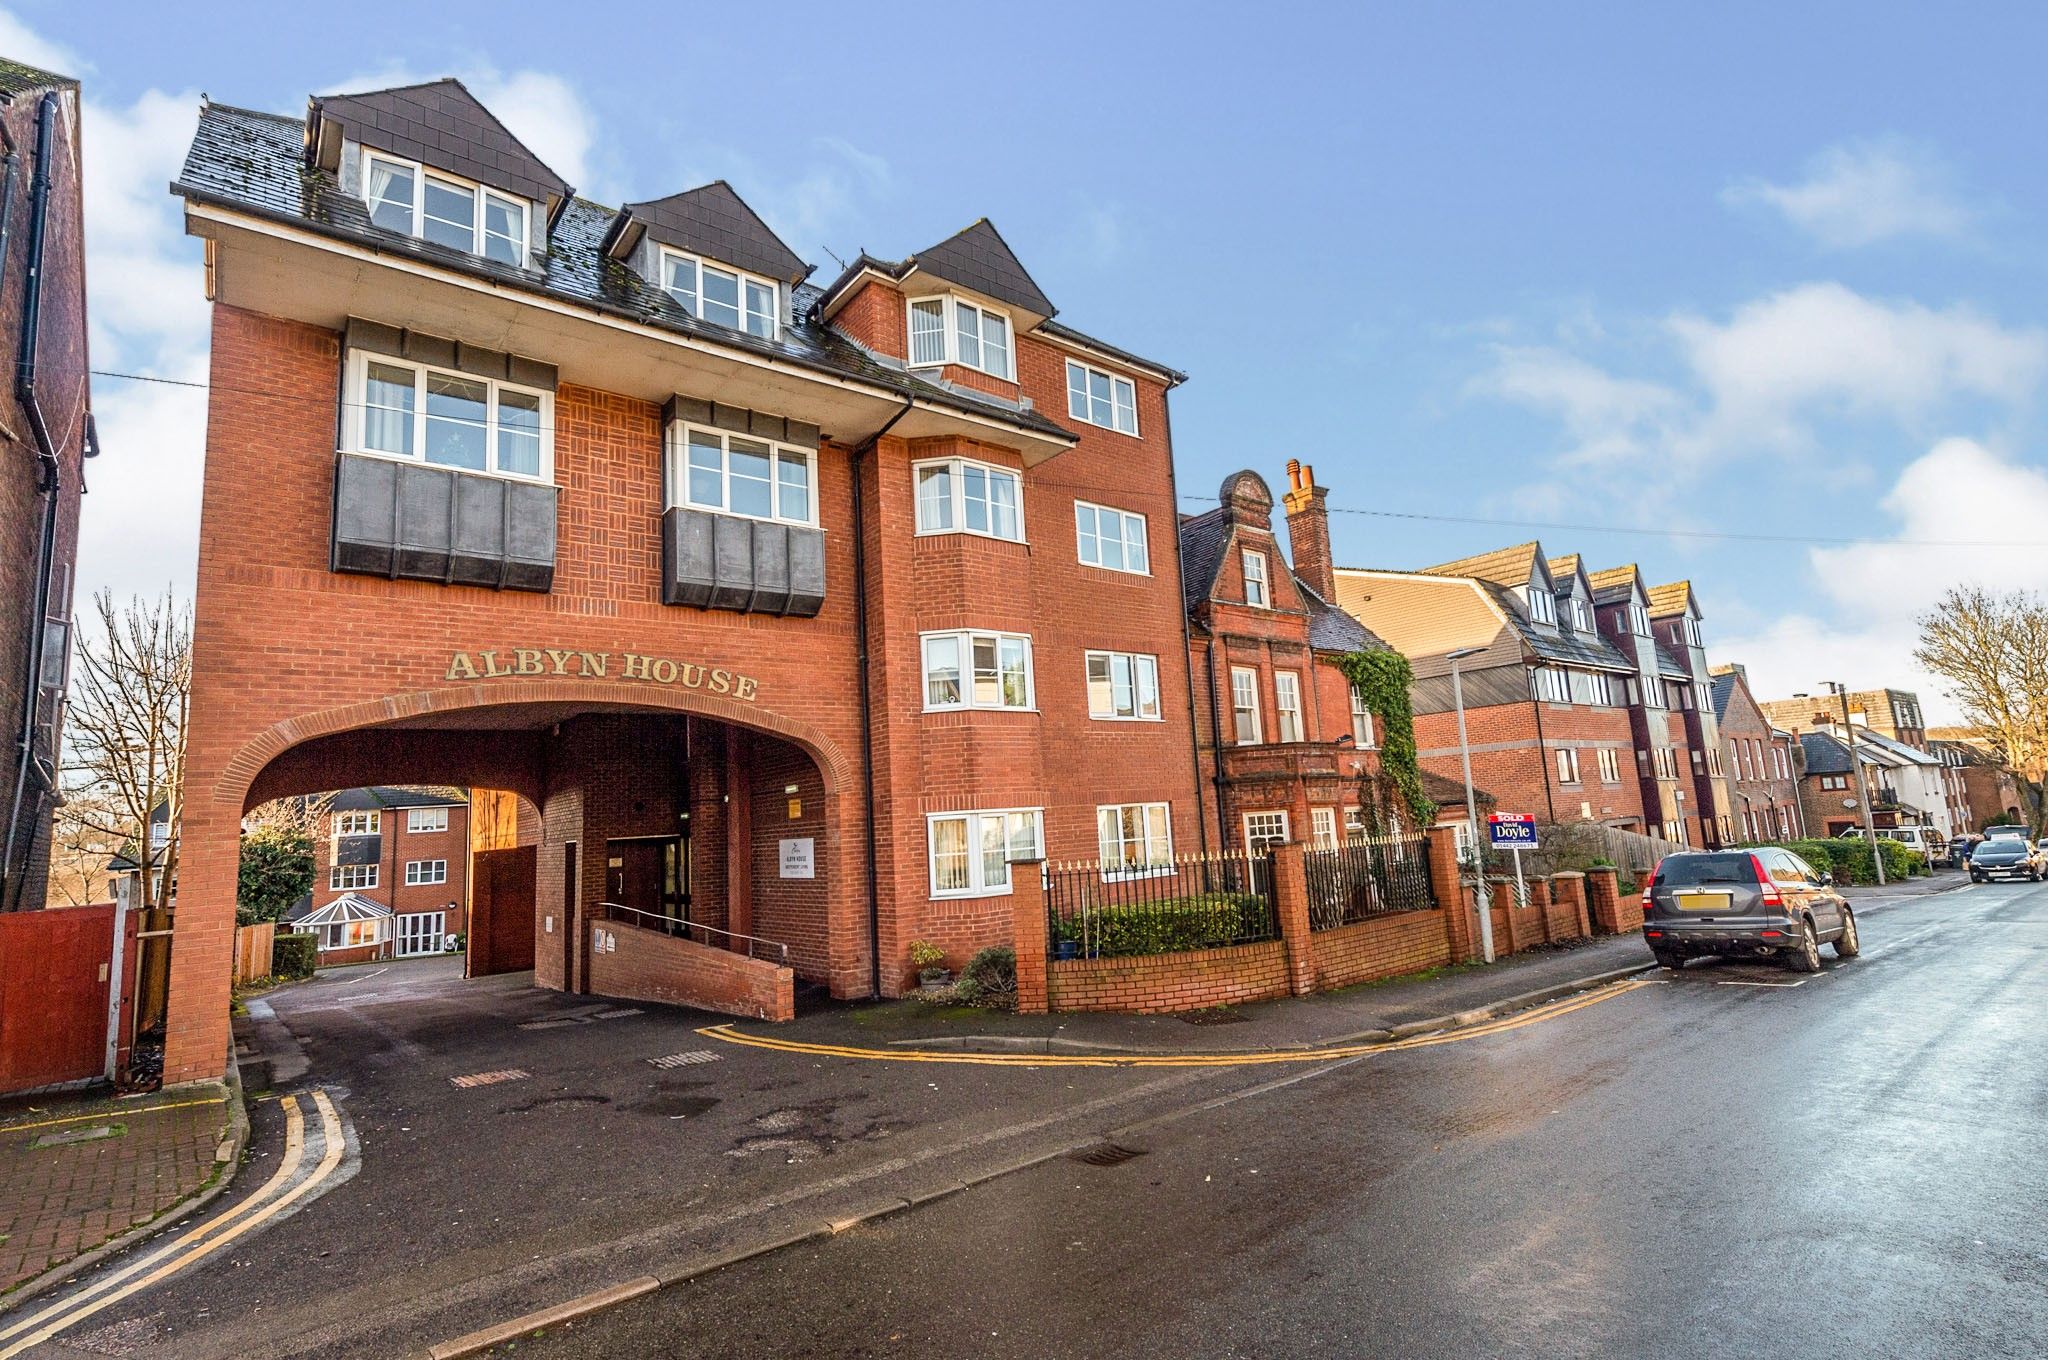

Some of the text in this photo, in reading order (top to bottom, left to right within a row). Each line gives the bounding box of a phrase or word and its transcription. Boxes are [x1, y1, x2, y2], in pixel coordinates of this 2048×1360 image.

[445, 648, 759, 702] ALBYN HOUSE
[1496, 825, 1530, 839] Doyle
